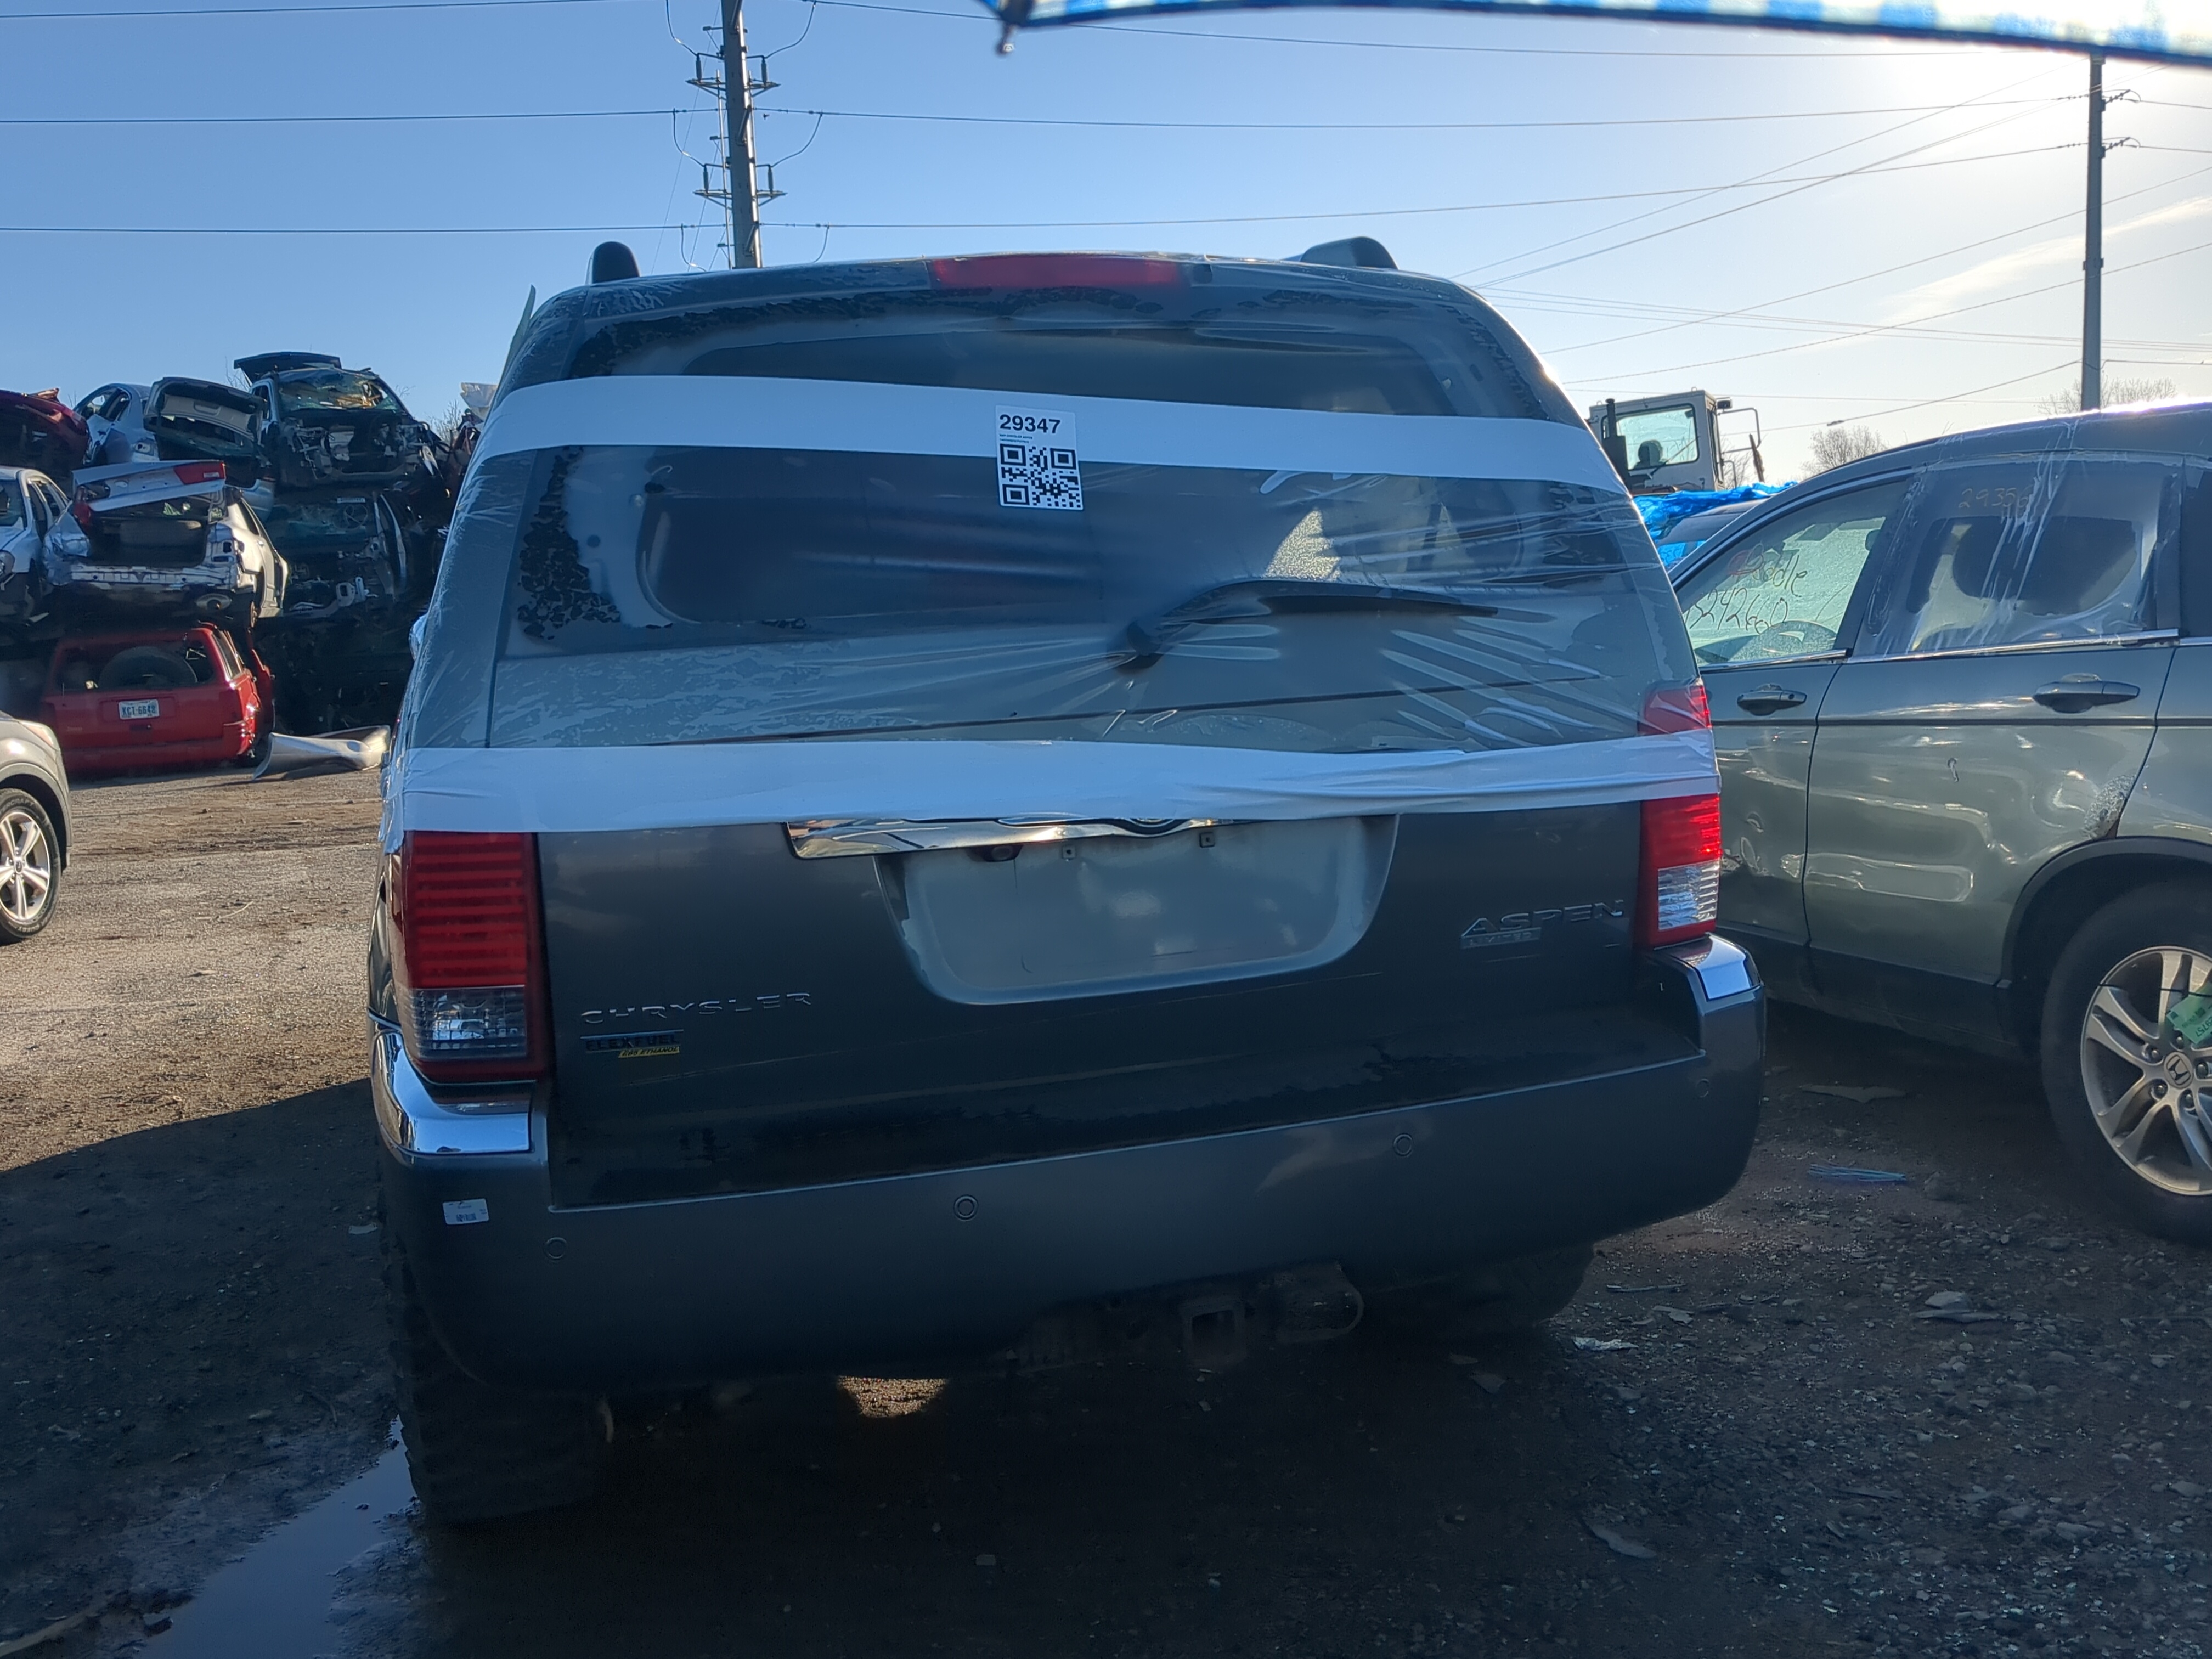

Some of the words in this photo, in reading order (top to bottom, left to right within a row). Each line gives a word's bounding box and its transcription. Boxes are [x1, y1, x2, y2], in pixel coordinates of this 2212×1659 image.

[1000, 414, 1061, 433] 29347
[1461, 899, 1624, 938] ASPEN
[580, 992, 812, 1024] CHRYSLER
[640, 1046, 678, 1055] ETHANOL
